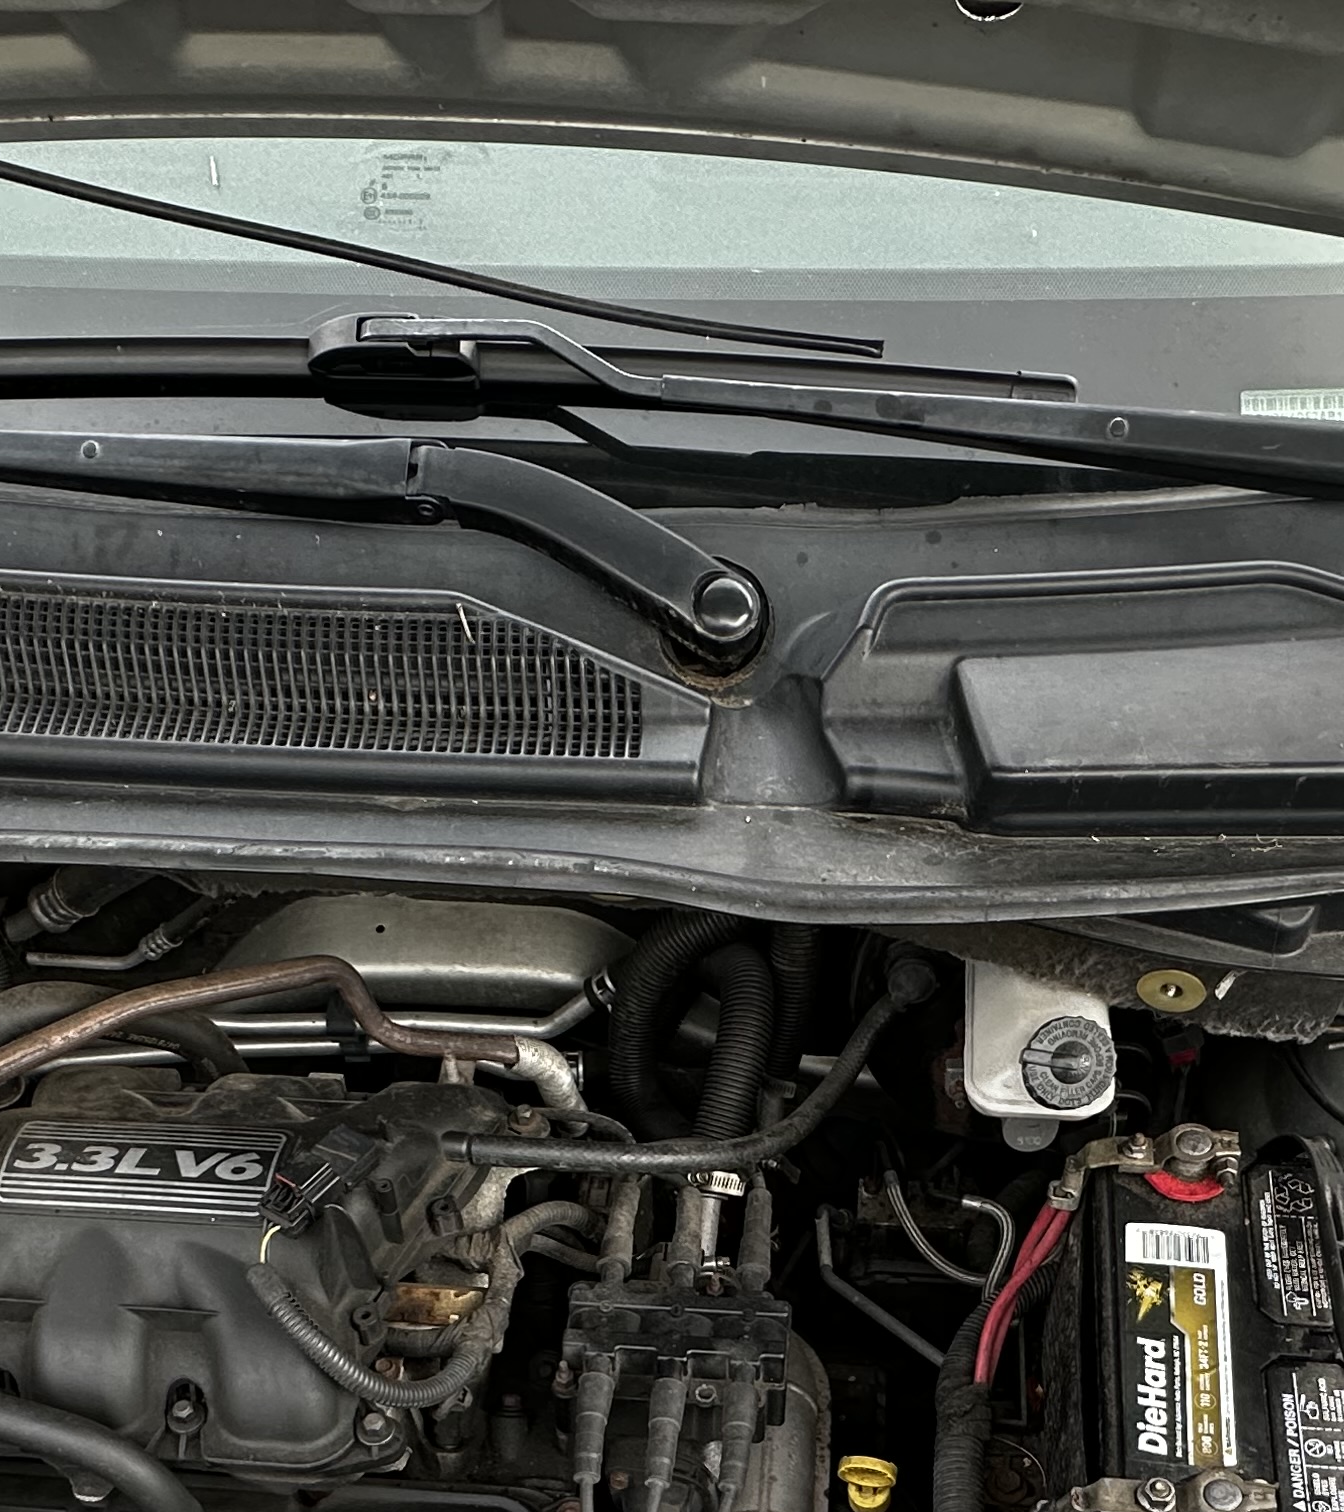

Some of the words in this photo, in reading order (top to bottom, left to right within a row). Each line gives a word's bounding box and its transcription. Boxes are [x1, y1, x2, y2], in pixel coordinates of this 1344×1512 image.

[1037, 1020, 1081, 1044] CONTAINER
[1047, 1030, 1088, 1046] REMOVING
[13, 1142, 161, 1176] 3.3L
[175, 1149, 264, 1181] V6
[1193, 1272, 1206, 1306] GOLD
[1136, 1336, 1168, 1456] DieHard
[1281, 1393, 1299, 1438] POISON
[1288, 1449, 1305, 1499] DANGER
